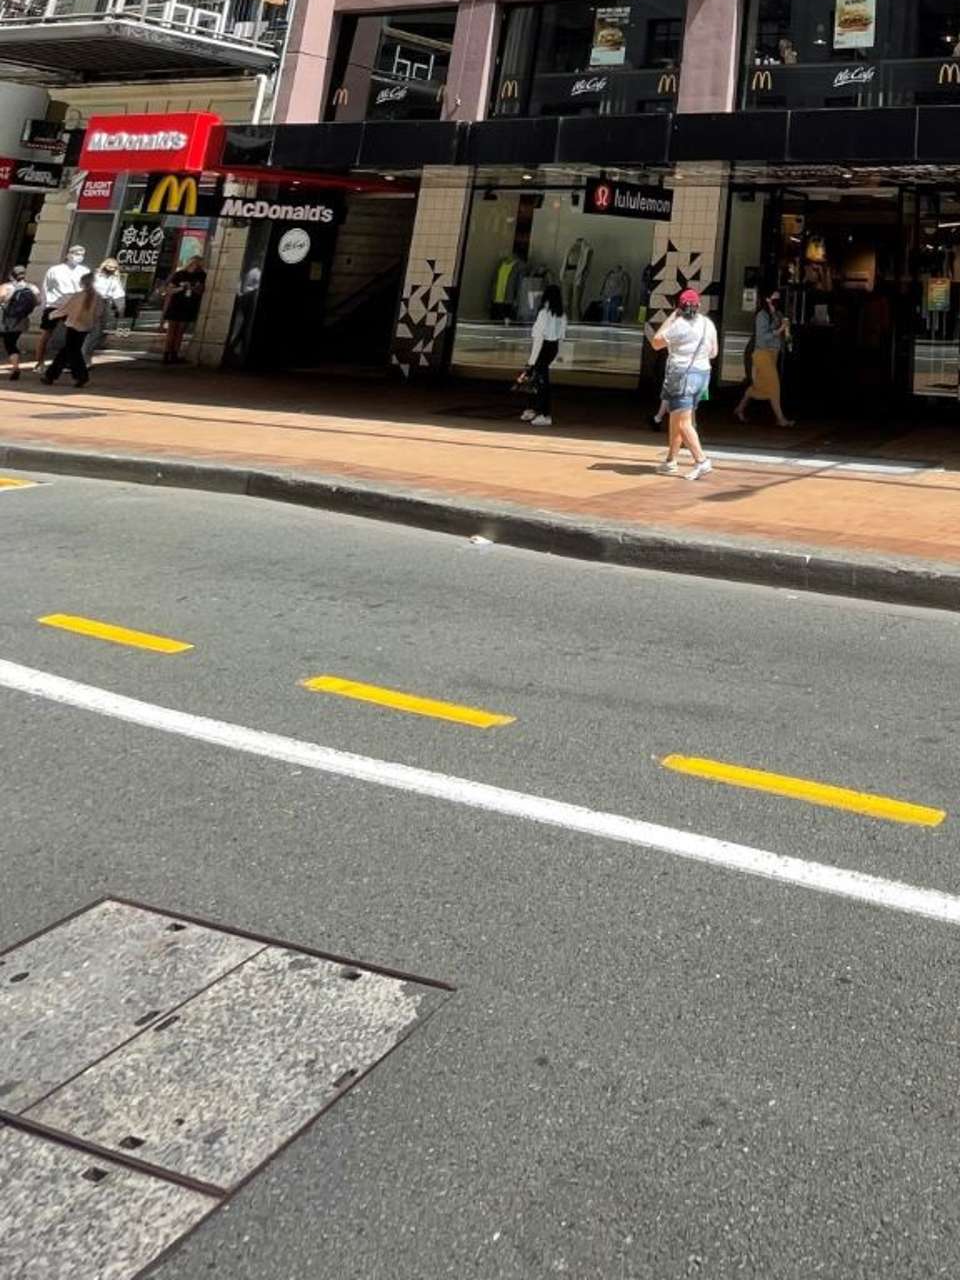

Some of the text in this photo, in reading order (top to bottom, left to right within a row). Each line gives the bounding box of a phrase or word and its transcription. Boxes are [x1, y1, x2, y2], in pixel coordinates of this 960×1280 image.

[85, 180, 113, 190] FLIGHT
[83, 189, 111, 198] CENTRE
[614, 187, 671, 213] lululemon
[220, 199, 334, 222] McDonald's
[117, 249, 160, 265] CRUISE
